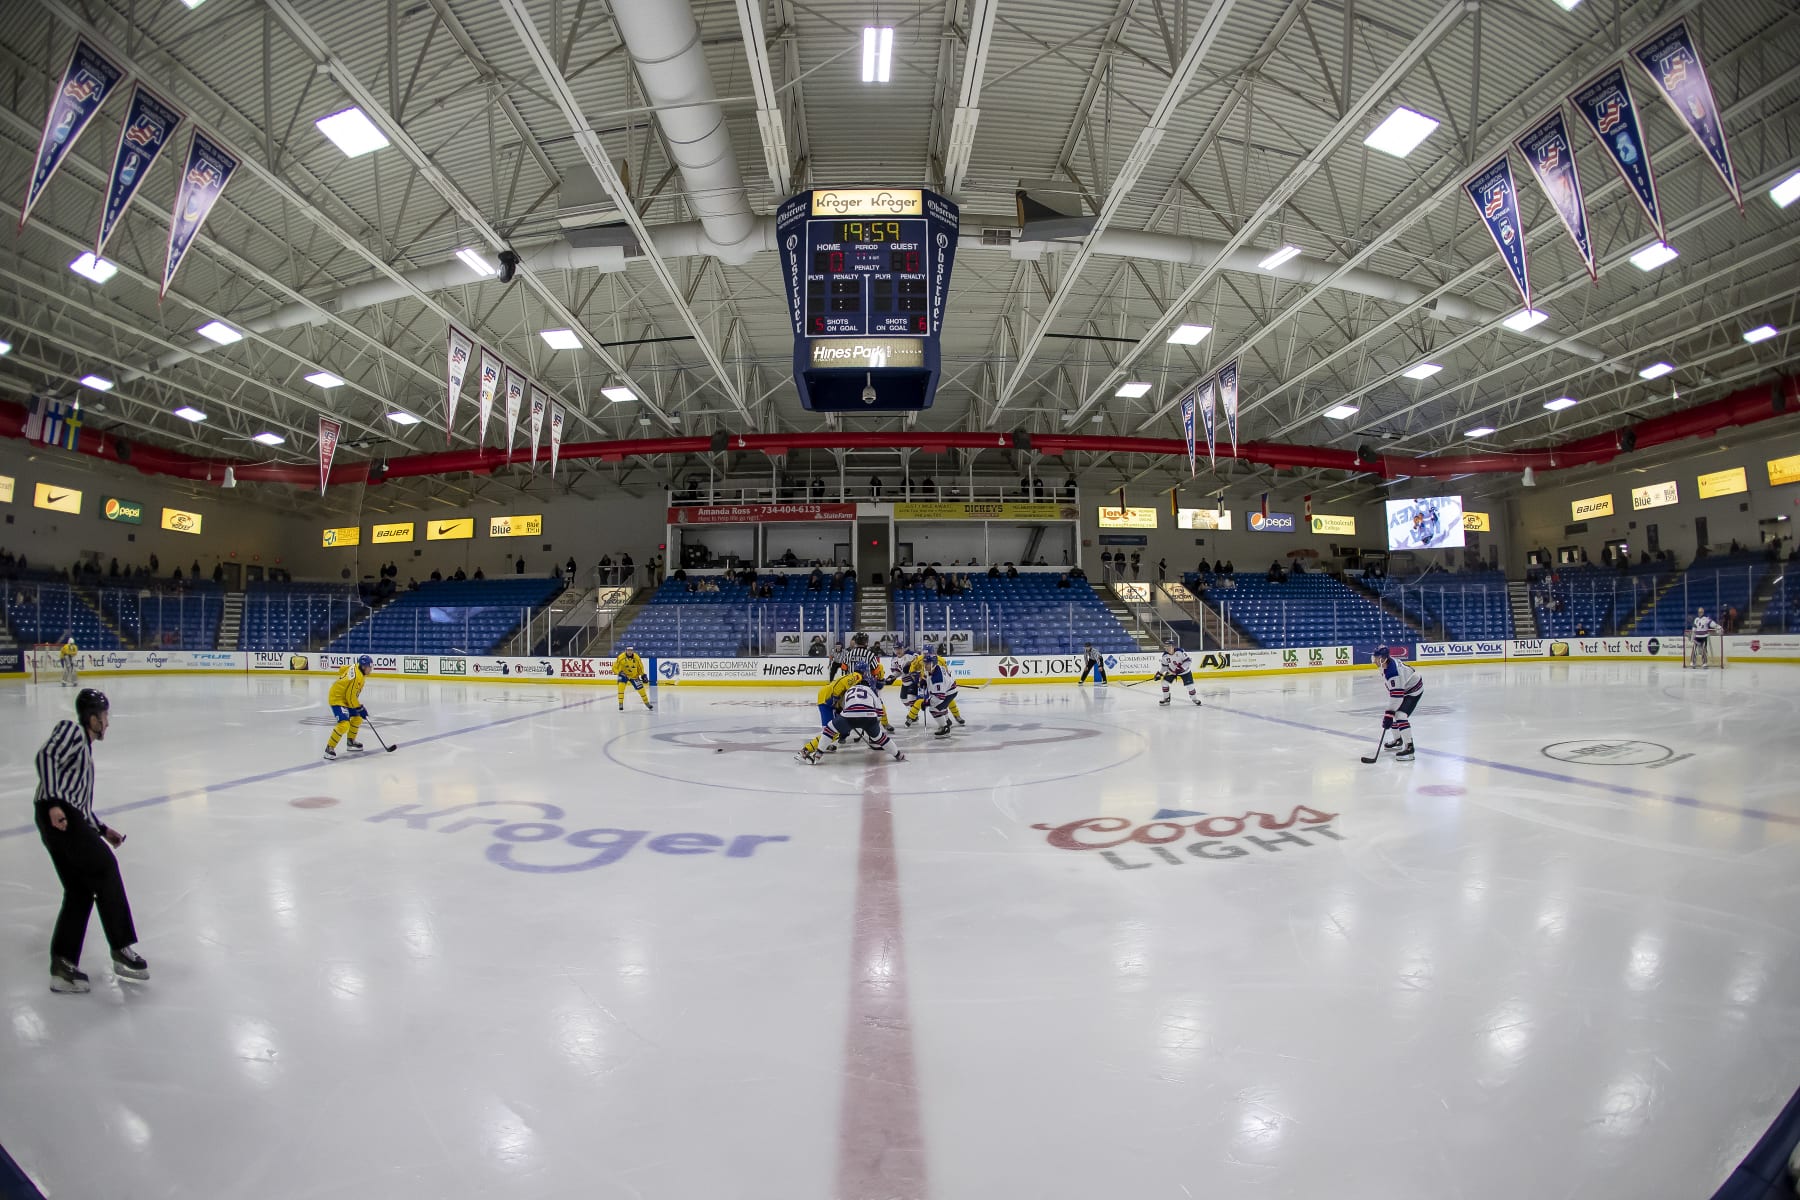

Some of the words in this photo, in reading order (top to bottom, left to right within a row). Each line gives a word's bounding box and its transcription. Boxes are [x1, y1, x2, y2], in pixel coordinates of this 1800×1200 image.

[816, 192, 863, 214] Kroger
[871, 192, 918, 214] Kroger
[843, 223, 900, 242] 19:59
[816, 243, 841, 251] HOME
[830, 251, 843, 273] 0
[813, 346, 851, 360] Hines
[1576, 501, 1609, 514] BAUER
[1634, 497, 1651, 508] Blue
[119, 506, 140, 518] pepsi
[1266, 517, 1292, 528] pepsi
[376, 529, 409, 537] BAUER
[492, 525, 511, 535] Blue
[1513, 640, 1543, 649] TRULY
[1585, 641, 1598, 653] tcf
[1607, 641, 1621, 653] tcf
[1630, 640, 1643, 653] tcf
[93, 655, 104, 667] tcf
[107, 653, 127, 668] Kroger
[147, 652, 168, 668] Kroger
[255, 653, 284, 661] TRULY
[330, 656, 351, 665] VISIT
[560, 659, 594, 673] K&K
[682, 661, 718, 669] BREWING
[720, 661, 758, 669] COMPANY
[763, 663, 796, 676] Hines
[797, 663, 824, 676] Park
[1022, 659, 1043, 674] ST.
[1045, 656, 1082, 673] JOE'S
[845, 687, 868, 700] 25
[1030, 805, 1340, 850] Coors
[365, 800, 792, 875] Kroger
[1100, 824, 1347, 870] LIGHT
